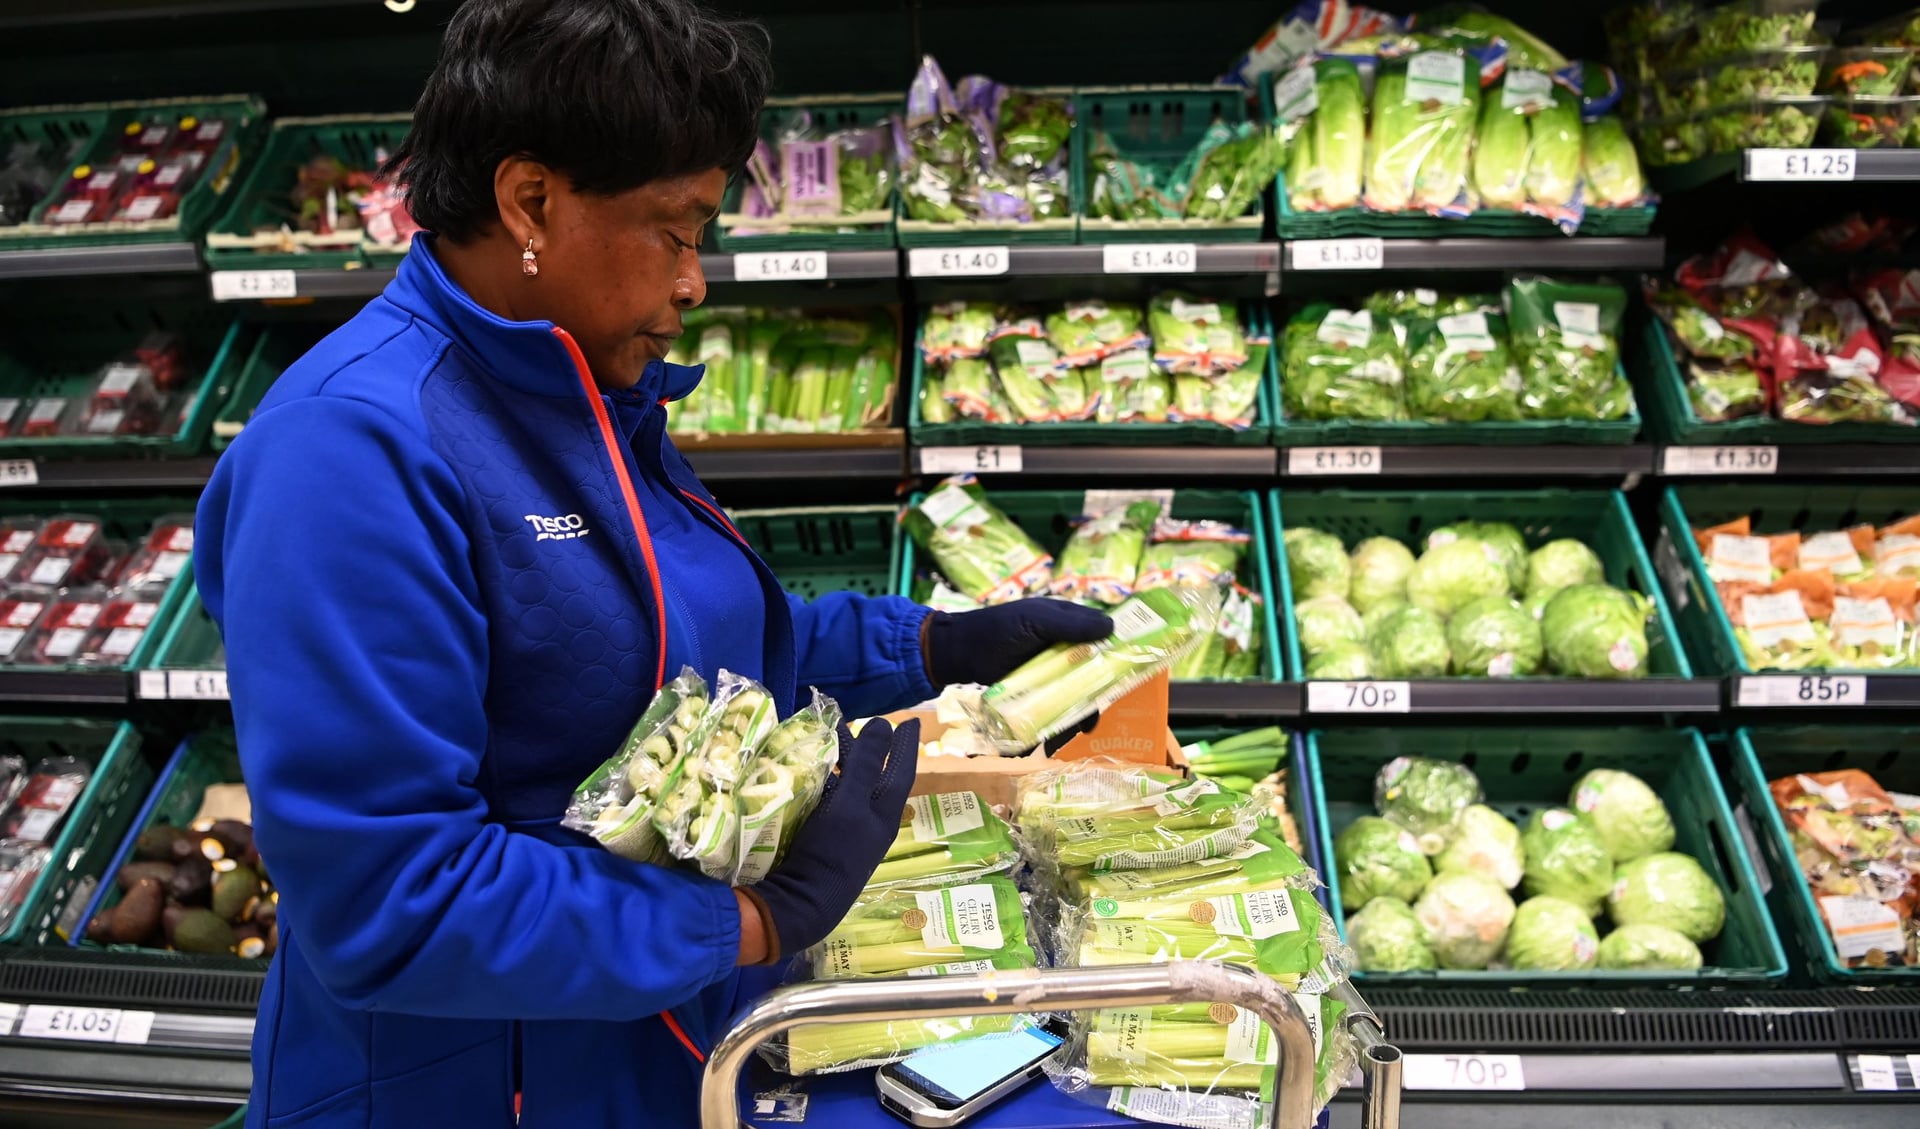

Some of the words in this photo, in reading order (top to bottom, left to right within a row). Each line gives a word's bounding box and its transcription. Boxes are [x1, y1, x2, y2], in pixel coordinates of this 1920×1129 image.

[1786, 155, 1850, 174] £1.25
[941, 252, 998, 270] £1.40
[1131, 249, 1190, 267] £1.40
[1320, 245, 1378, 261] £1.30
[761, 257, 817, 274] £1.40
[976, 446, 999, 468] £1
[1315, 451, 1372, 468] £1.30
[1714, 449, 1772, 468] £1.30
[1345, 685, 1396, 707] 70p
[1798, 676, 1850, 700] 85p
[1089, 736, 1154, 753] QUAKER
[1247, 893, 1262, 925] STICKS
[1277, 893, 1288, 916] TESCO
[957, 901, 971, 935] STICKS
[967, 898, 982, 936] CELERY
[983, 902, 995, 931] TESCO
[838, 938, 846, 949] 24
[840, 950, 850, 970] MAY
[49, 1010, 112, 1032] £1.05
[1129, 1013, 1138, 1022] 24
[1126, 1024, 1137, 1050] MAY
[1444, 1058, 1507, 1085] 70p
